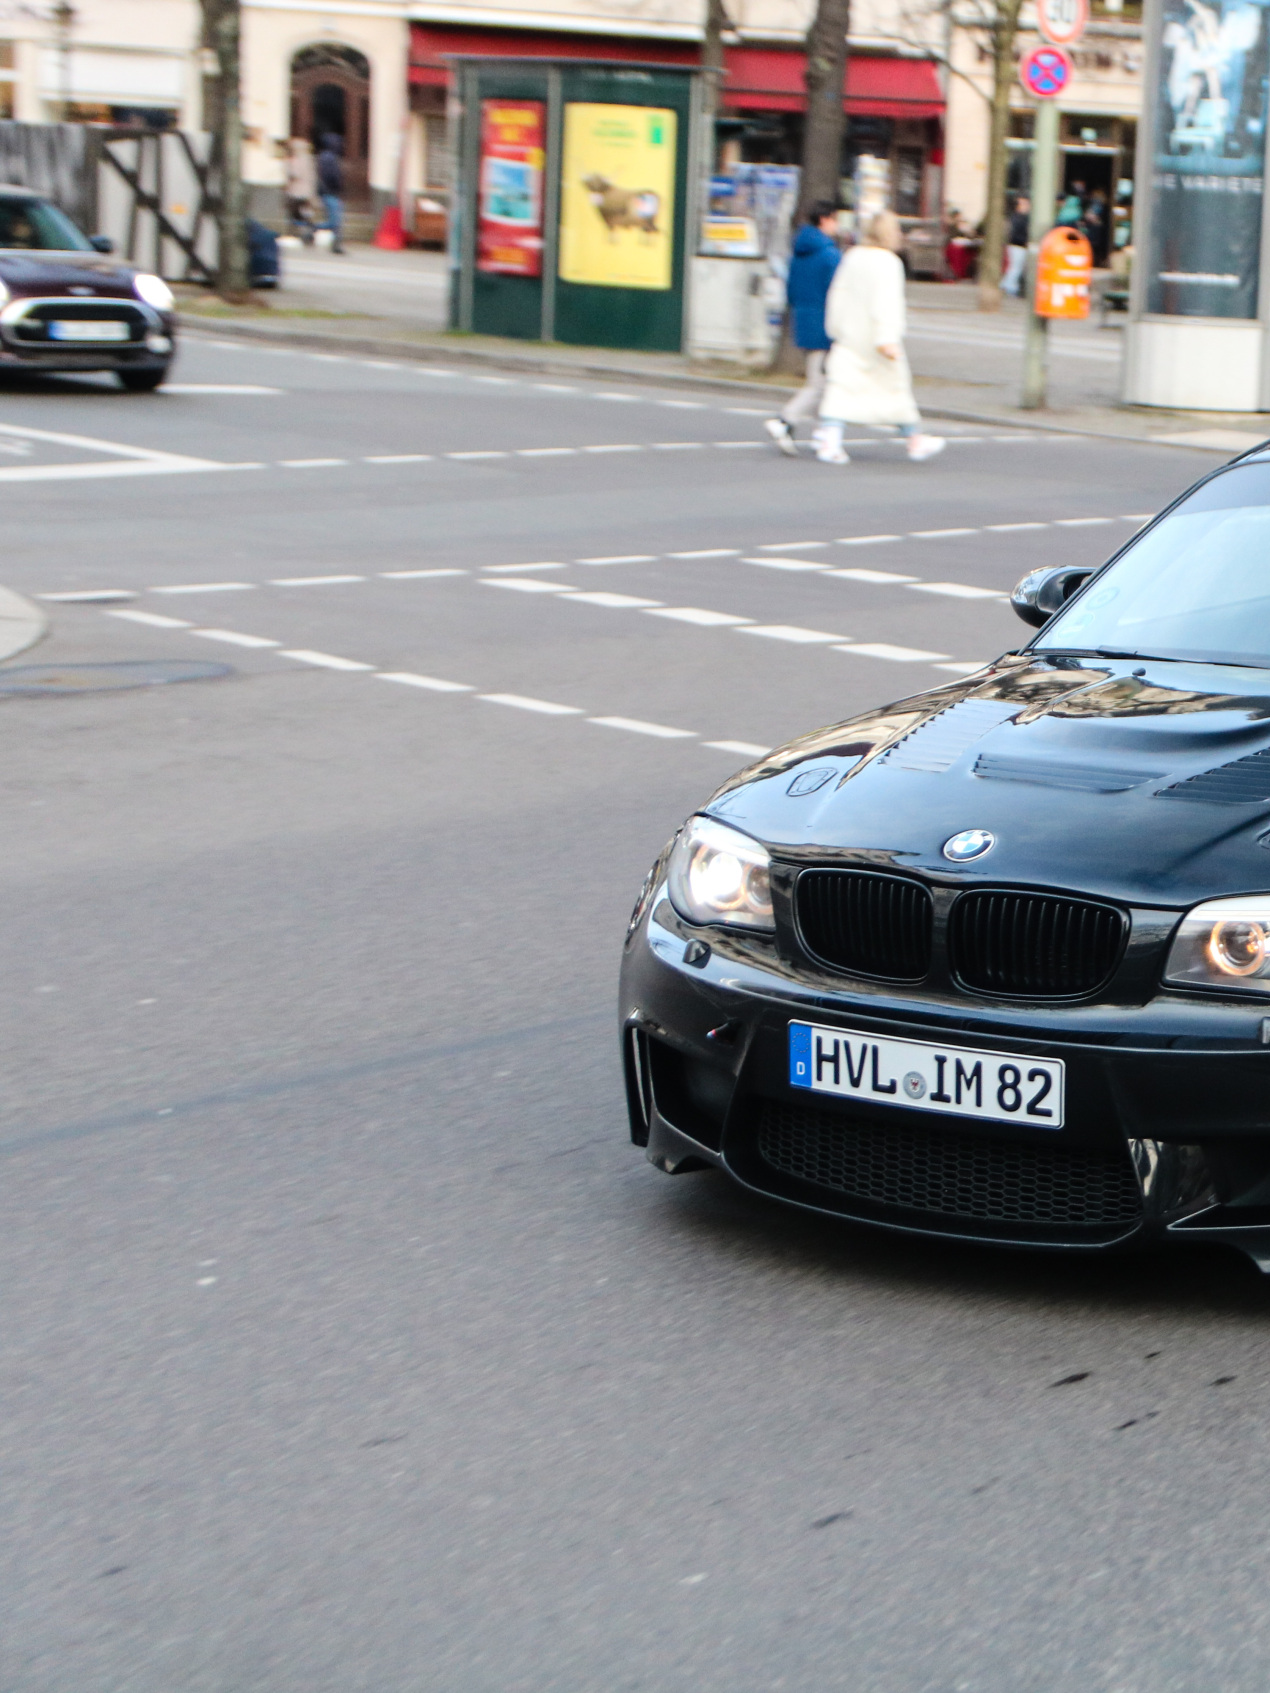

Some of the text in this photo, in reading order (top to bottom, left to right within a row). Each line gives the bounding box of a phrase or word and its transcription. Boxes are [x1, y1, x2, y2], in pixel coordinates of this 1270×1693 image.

[815, 1035, 1054, 1118] HVL IM 82
